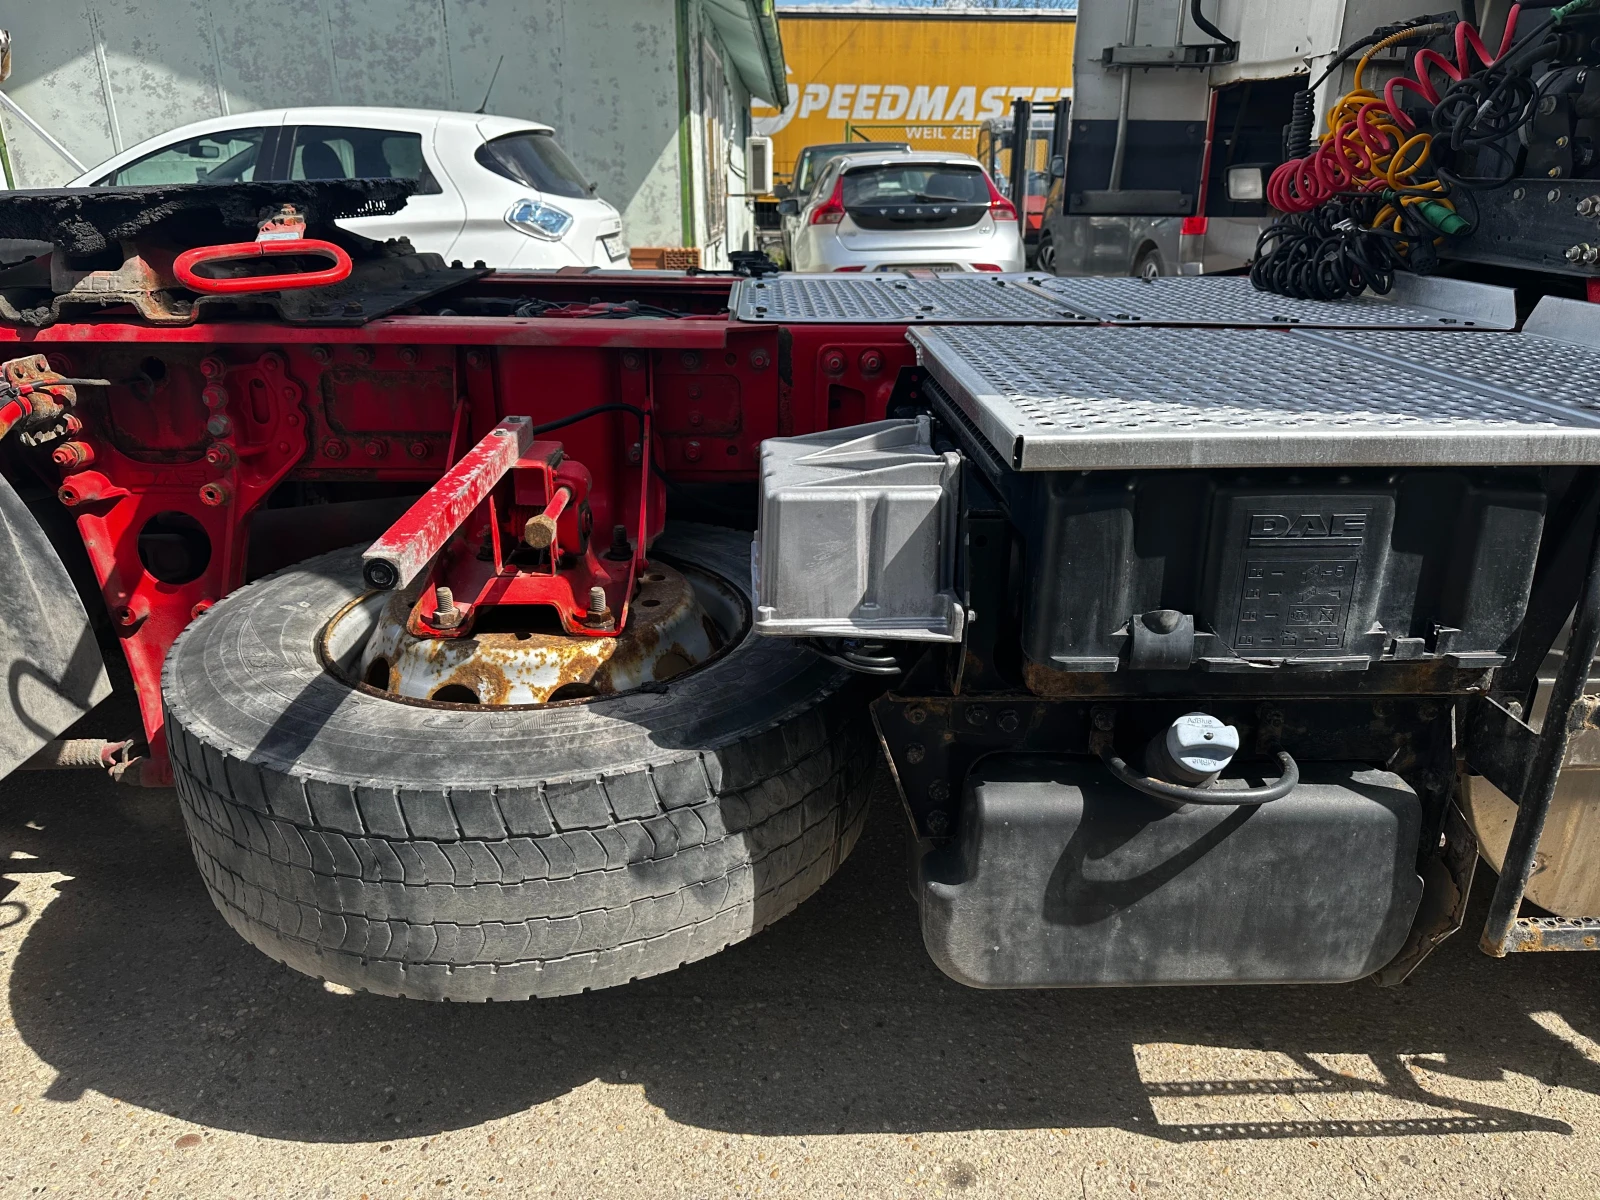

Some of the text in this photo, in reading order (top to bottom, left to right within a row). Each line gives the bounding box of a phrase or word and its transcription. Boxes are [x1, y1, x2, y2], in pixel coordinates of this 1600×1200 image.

[751, 64, 1073, 135] SPEEDMASTE
[906, 126, 980, 140] WEIL ZEI
[879, 207, 958, 215] VOLVO
[1250, 514, 1367, 538] DAF
[1187, 717, 1213, 725] AdBlue
